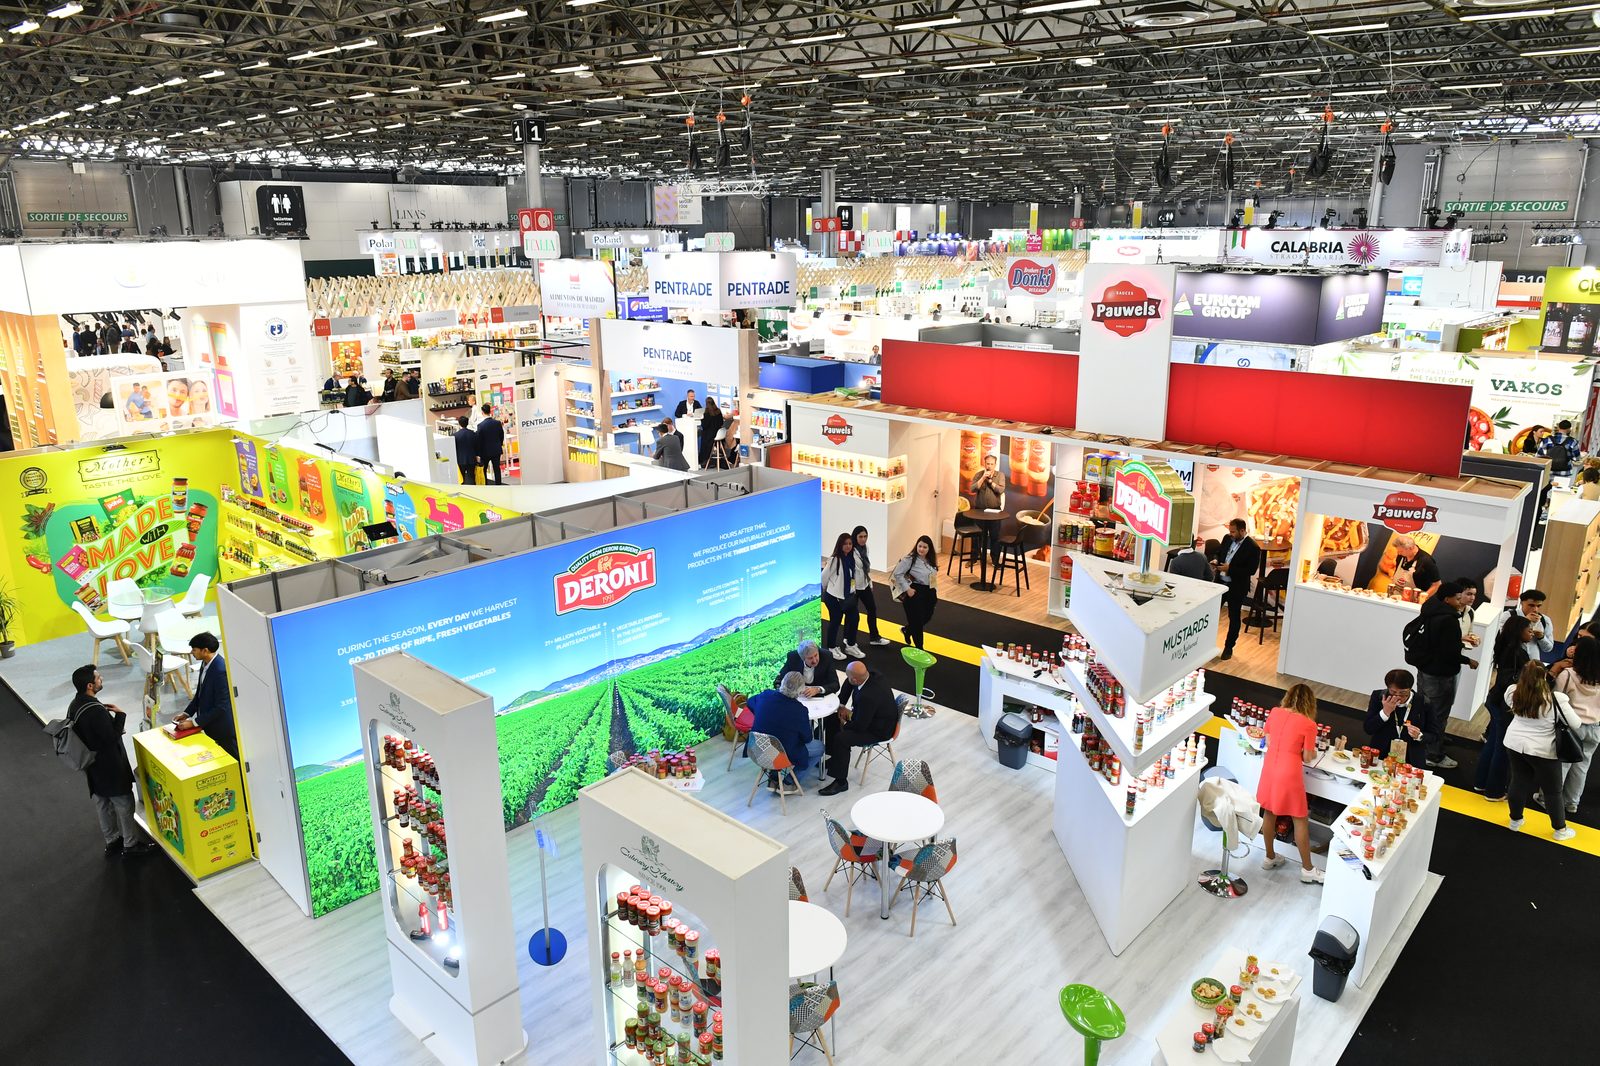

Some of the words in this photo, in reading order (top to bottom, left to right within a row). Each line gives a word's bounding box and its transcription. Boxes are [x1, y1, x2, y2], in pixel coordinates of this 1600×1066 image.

[515, 126, 522, 141] 1
[531, 126, 542, 140] 1
[1446, 202, 1486, 212] SORTIE
[1490, 202, 1504, 211] DE
[1509, 202, 1567, 211] SECOURS
[1271, 241, 1344, 254] CALABRIA
[1013, 267, 1052, 286] Donki
[654, 281, 712, 296] PENTRADE
[728, 281, 790, 296] PENTRADE
[1194, 294, 1261, 308] EURICOM
[1096, 302, 1156, 318] Pauwels
[1202, 306, 1252, 320] GROUP
[643, 346, 692, 363] PENTRADE
[1491, 379, 1562, 396] VAKOS
[522, 416, 556, 427] PENTRADE
[824, 426, 850, 434] Pauwels
[83, 481, 112, 490] TASTE
[137, 473, 161, 482] LOVE
[1116, 480, 1165, 534] DERONI
[1378, 506, 1432, 520] Pauwels
[88, 498, 172, 568] MADE
[720, 530, 738, 540] HOURS
[738, 526, 754, 535] AFTER
[702, 543, 728, 555] PRODUCE
[728, 540, 739, 548] OUR
[739, 532, 767, 544] NATURALLY
[571, 556, 589, 572] QUALITY
[590, 550, 602, 559] FROM
[688, 556, 716, 570] PRODUCTS
[722, 550, 732, 559] THE
[563, 560, 648, 605] DERONI
[337, 640, 372, 656] DURING
[374, 635, 390, 646] THE
[391, 625, 427, 640] SEASON,
[428, 616, 453, 630] EVERY
[455, 611, 470, 622] DAY
[470, 608, 484, 618] WE
[484, 598, 518, 614] HARVEST
[554, 633, 574, 644] MILLION
[574, 623, 601, 636] VEGETABLE
[1163, 614, 1209, 654] MUSTARDS
[349, 651, 375, 665] 60-70
[376, 644, 400, 657] TONS
[400, 639, 413, 650] OF
[414, 635, 436, 646] RIPE,
[436, 626, 462, 640] FRESH
[462, 611, 512, 631] VEGETABLES
[620, 847, 655, 876] Culinary
